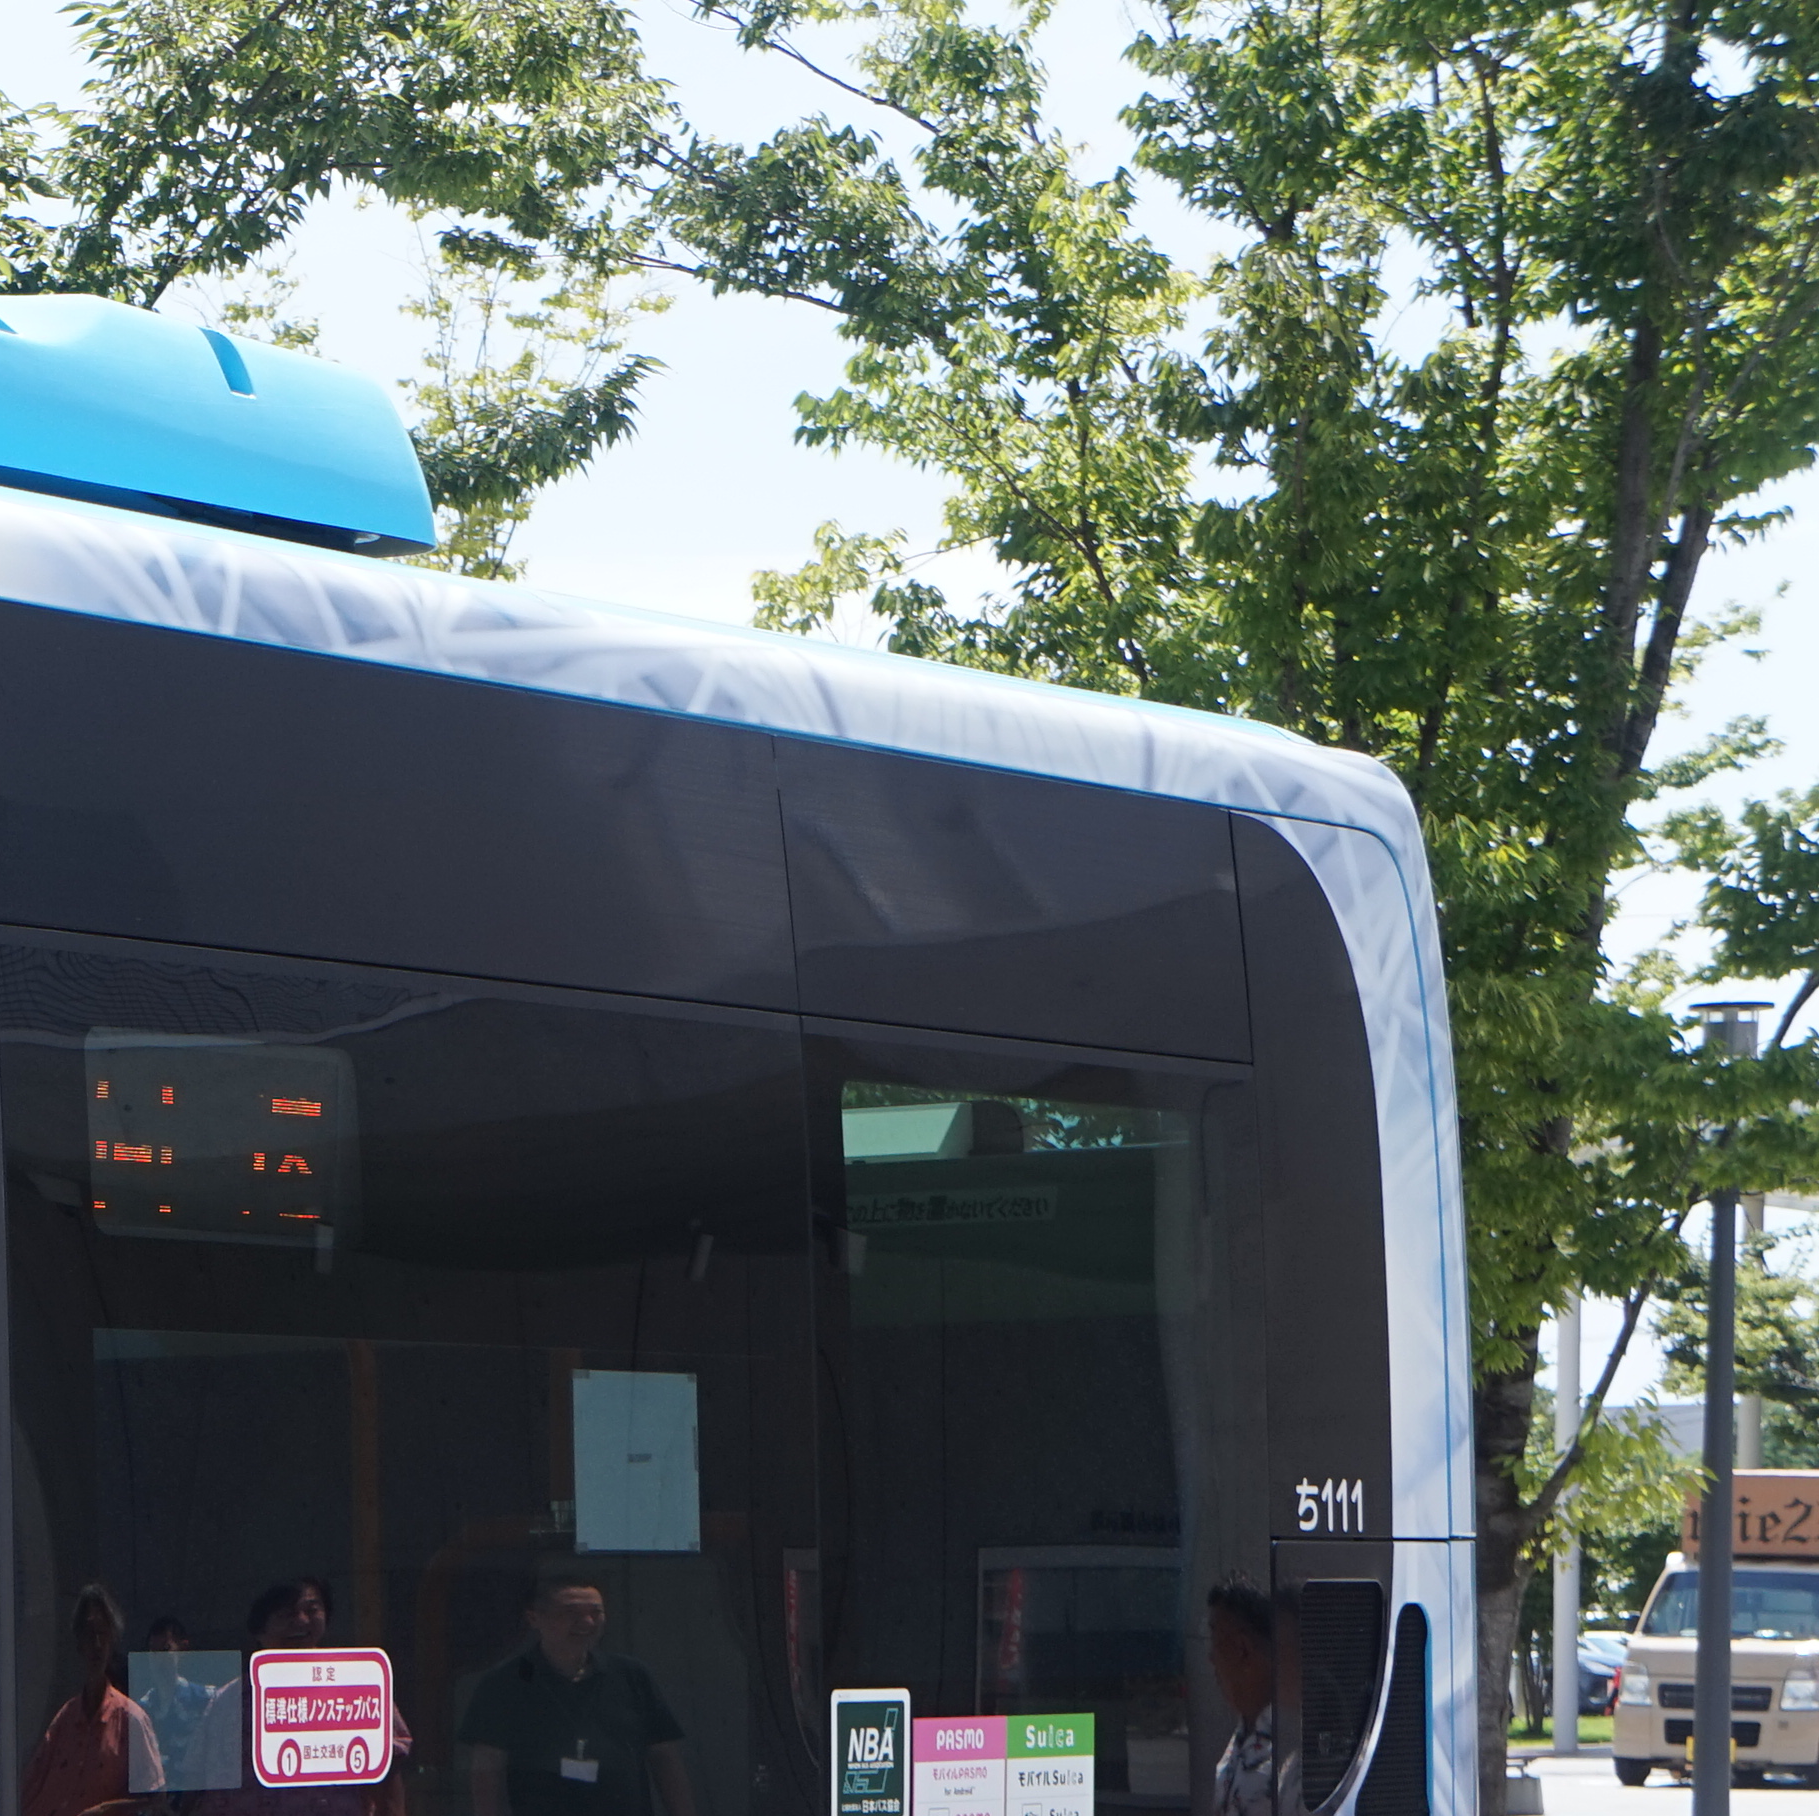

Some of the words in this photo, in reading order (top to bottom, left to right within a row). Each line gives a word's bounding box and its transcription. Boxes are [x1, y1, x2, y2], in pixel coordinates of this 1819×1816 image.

[1296, 1477, 1363, 1533] ち111
[265, 1695, 381, 1725] 標準仕様ノンステップバス
[848, 1727, 894, 1762] NBA
[936, 1728, 985, 1751] PASMO
[1025, 1723, 1075, 1749] Suica
[1018, 1769, 1084, 1787] モバイルSuica
